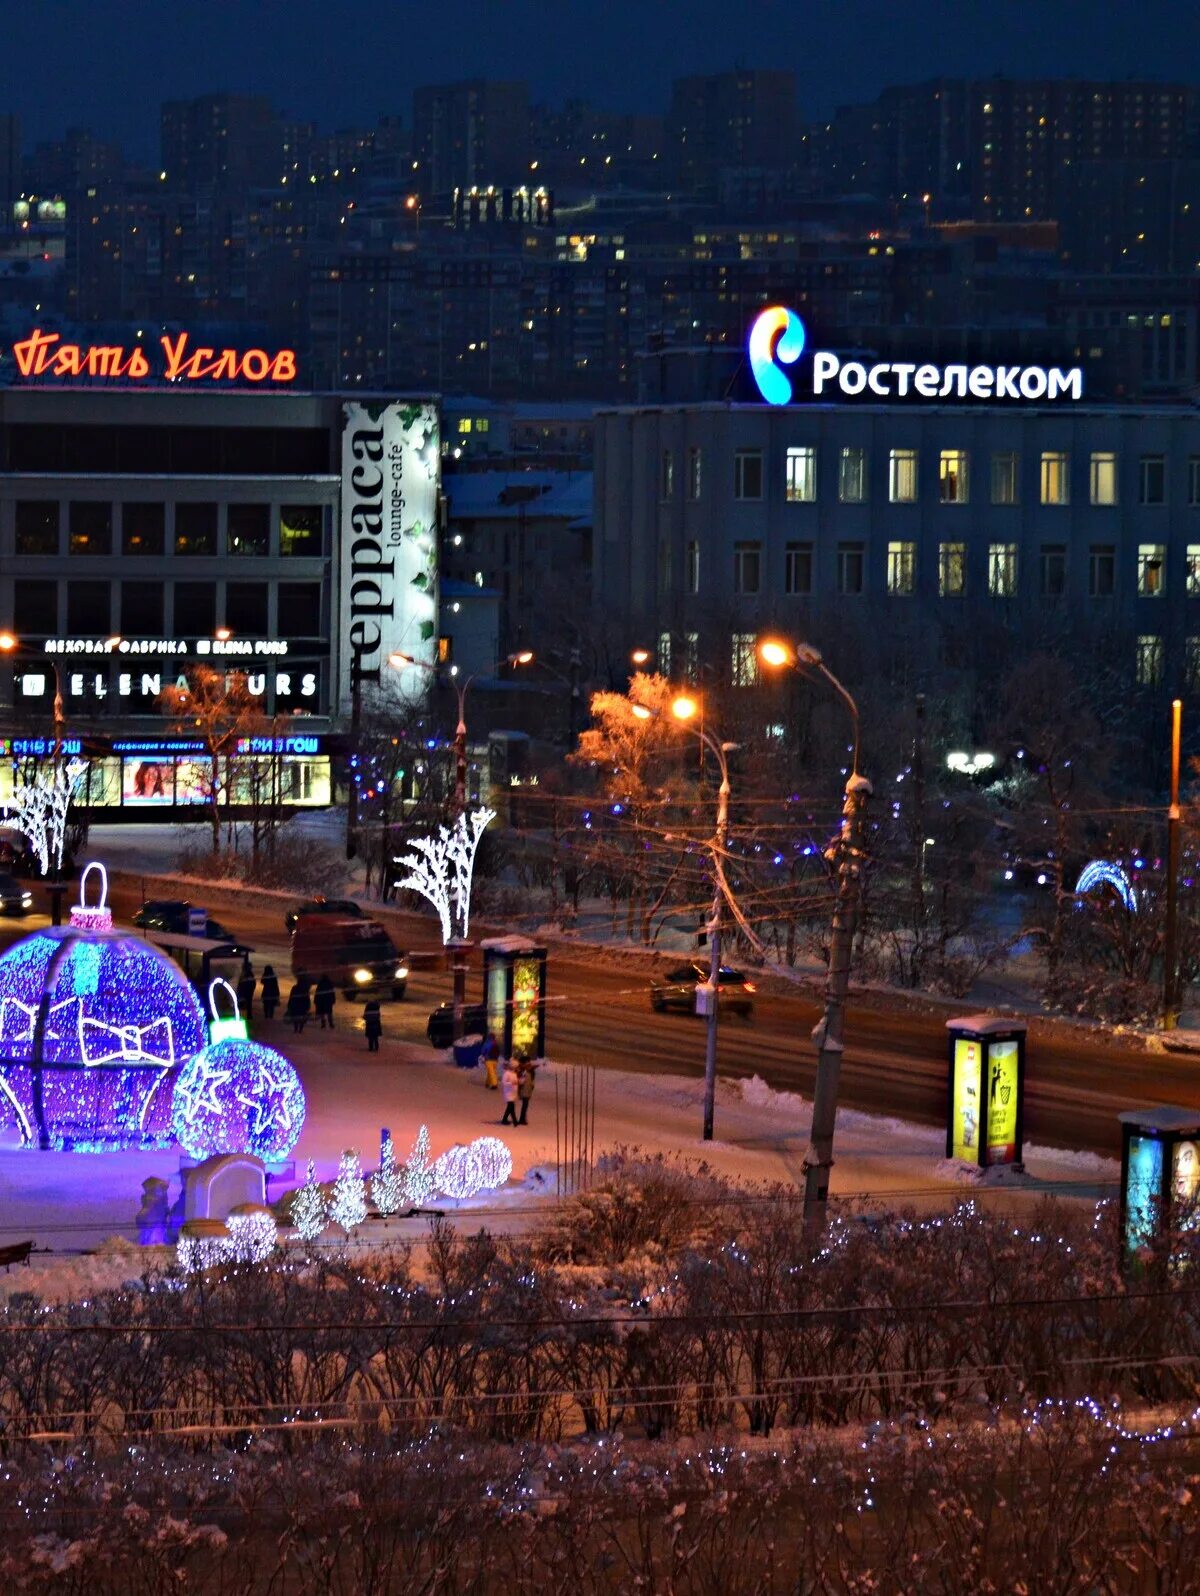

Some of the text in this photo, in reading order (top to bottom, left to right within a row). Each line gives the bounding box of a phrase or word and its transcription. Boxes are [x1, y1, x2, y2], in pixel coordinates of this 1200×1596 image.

[13, 329, 149, 377] Пять
[812, 351, 1083, 400] Ростелеком
[45, 640, 188, 654] МЕХОВАЯ ФАБРИКА
[212, 640, 288, 655] ELENA FURS
[70, 673, 191, 697] ELENA
[286, 737, 318, 753] ГОШ
